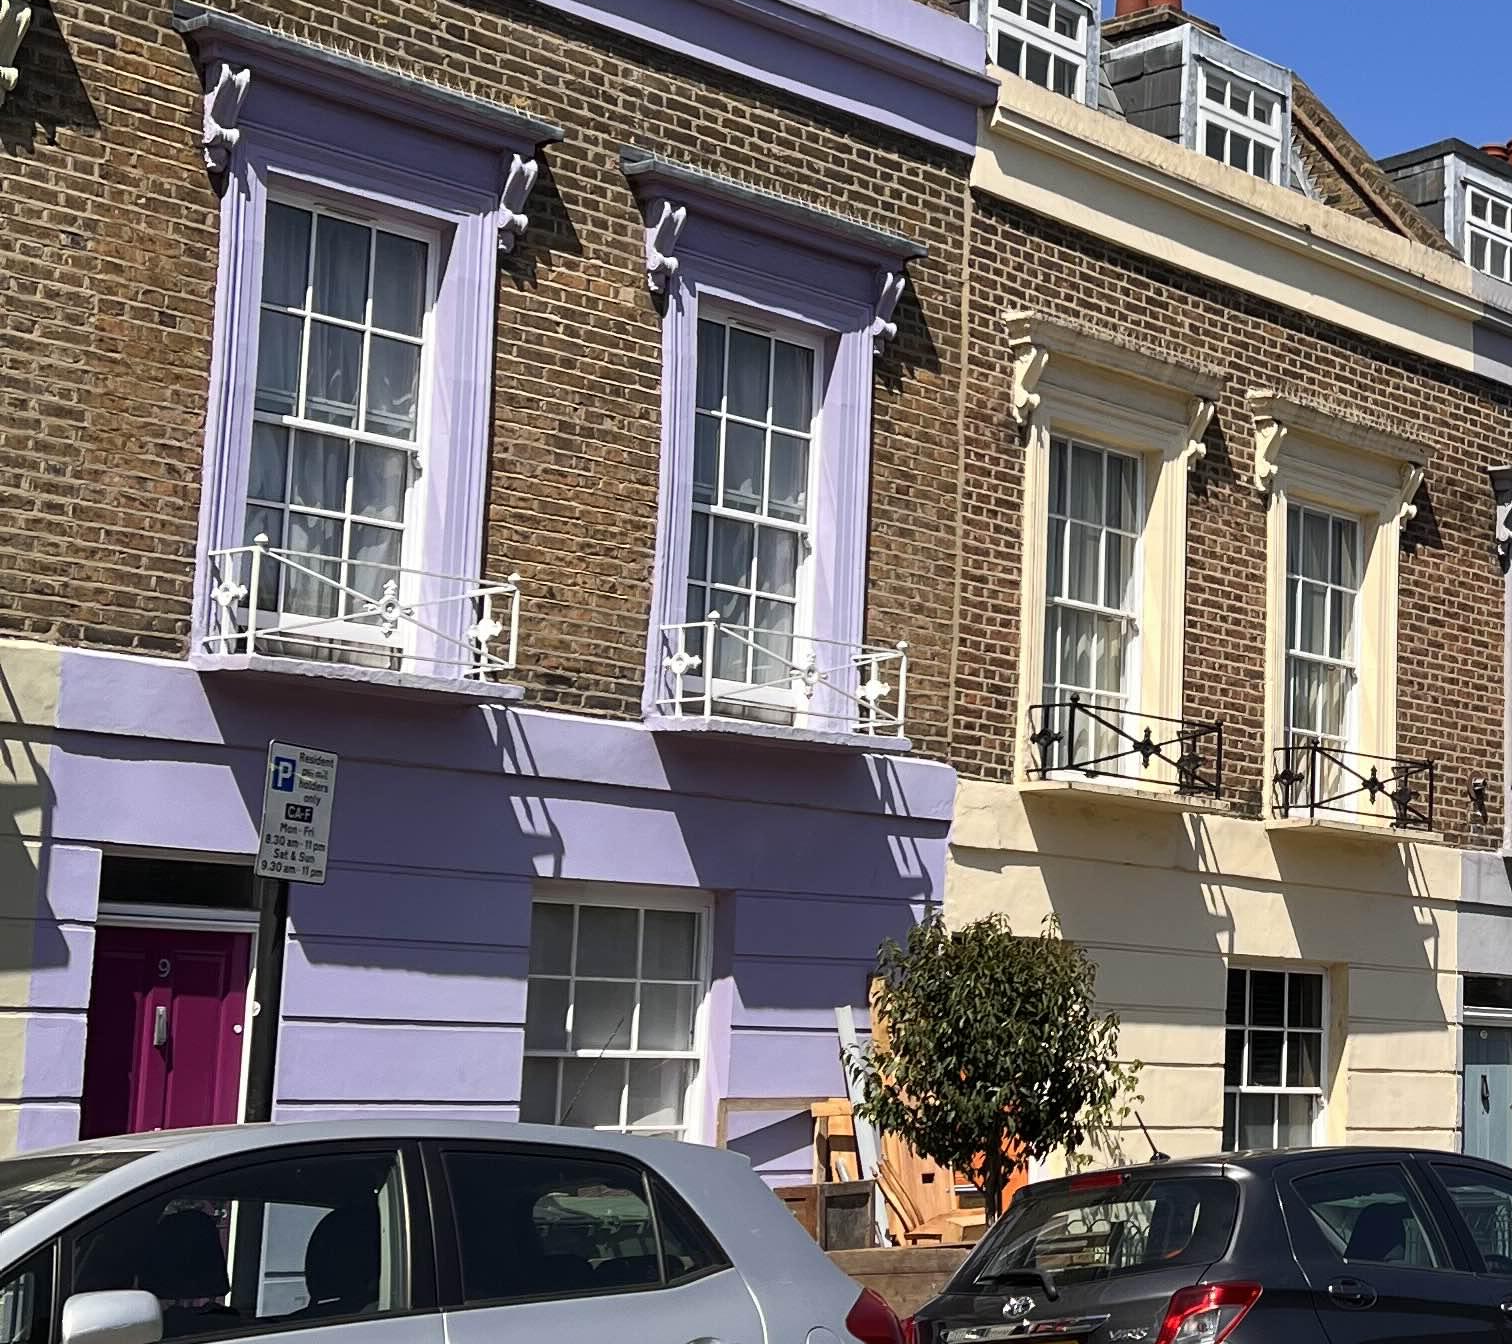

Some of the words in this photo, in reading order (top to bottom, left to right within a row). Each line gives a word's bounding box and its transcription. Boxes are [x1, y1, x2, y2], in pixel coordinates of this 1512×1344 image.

[299, 752, 334, 768] Resident
[277, 761, 293, 787] P
[303, 795, 321, 806] only
[287, 805, 312, 821] CA-F
[280, 822, 298, 834] Mon
[304, 826, 314, 837] Fri
[265, 833, 286, 846] 8.30
[273, 848, 289, 860] Sat
[298, 851, 316, 864] Sun
[261, 859, 283, 872] 9.30
[158, 958, 171, 978] 9
